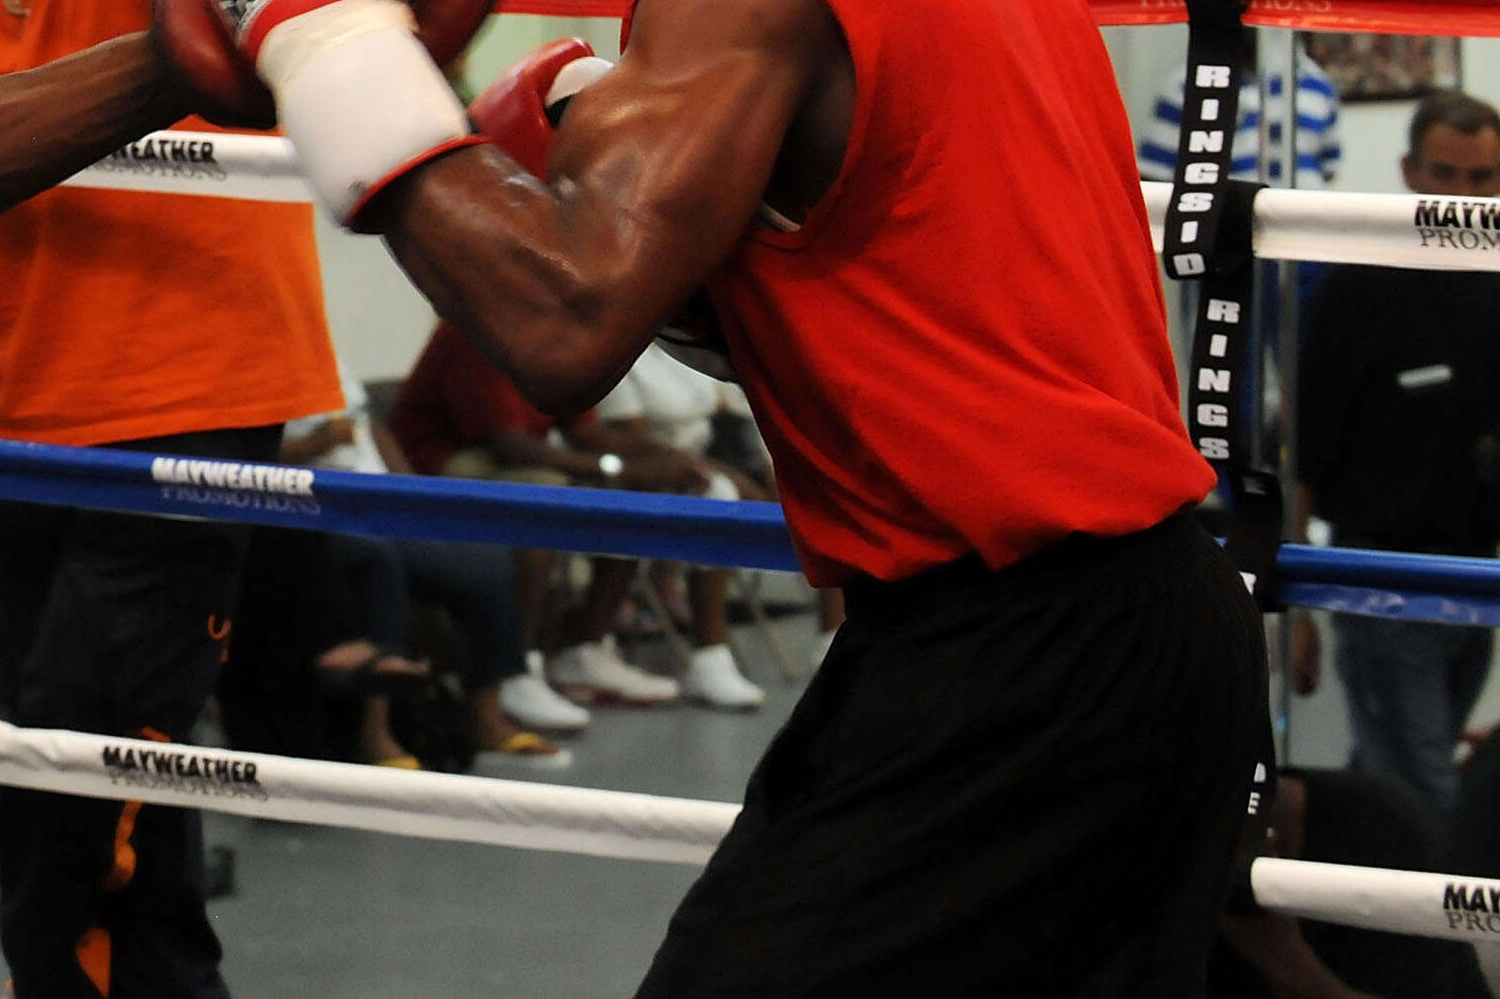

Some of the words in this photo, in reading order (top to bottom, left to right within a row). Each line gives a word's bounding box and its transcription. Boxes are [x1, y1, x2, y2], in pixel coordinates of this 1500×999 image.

[110, 139, 217, 163] WEATHER
[152, 457, 315, 496] MAYWEATHER
[102, 746, 260, 786] MAYWEATHER
